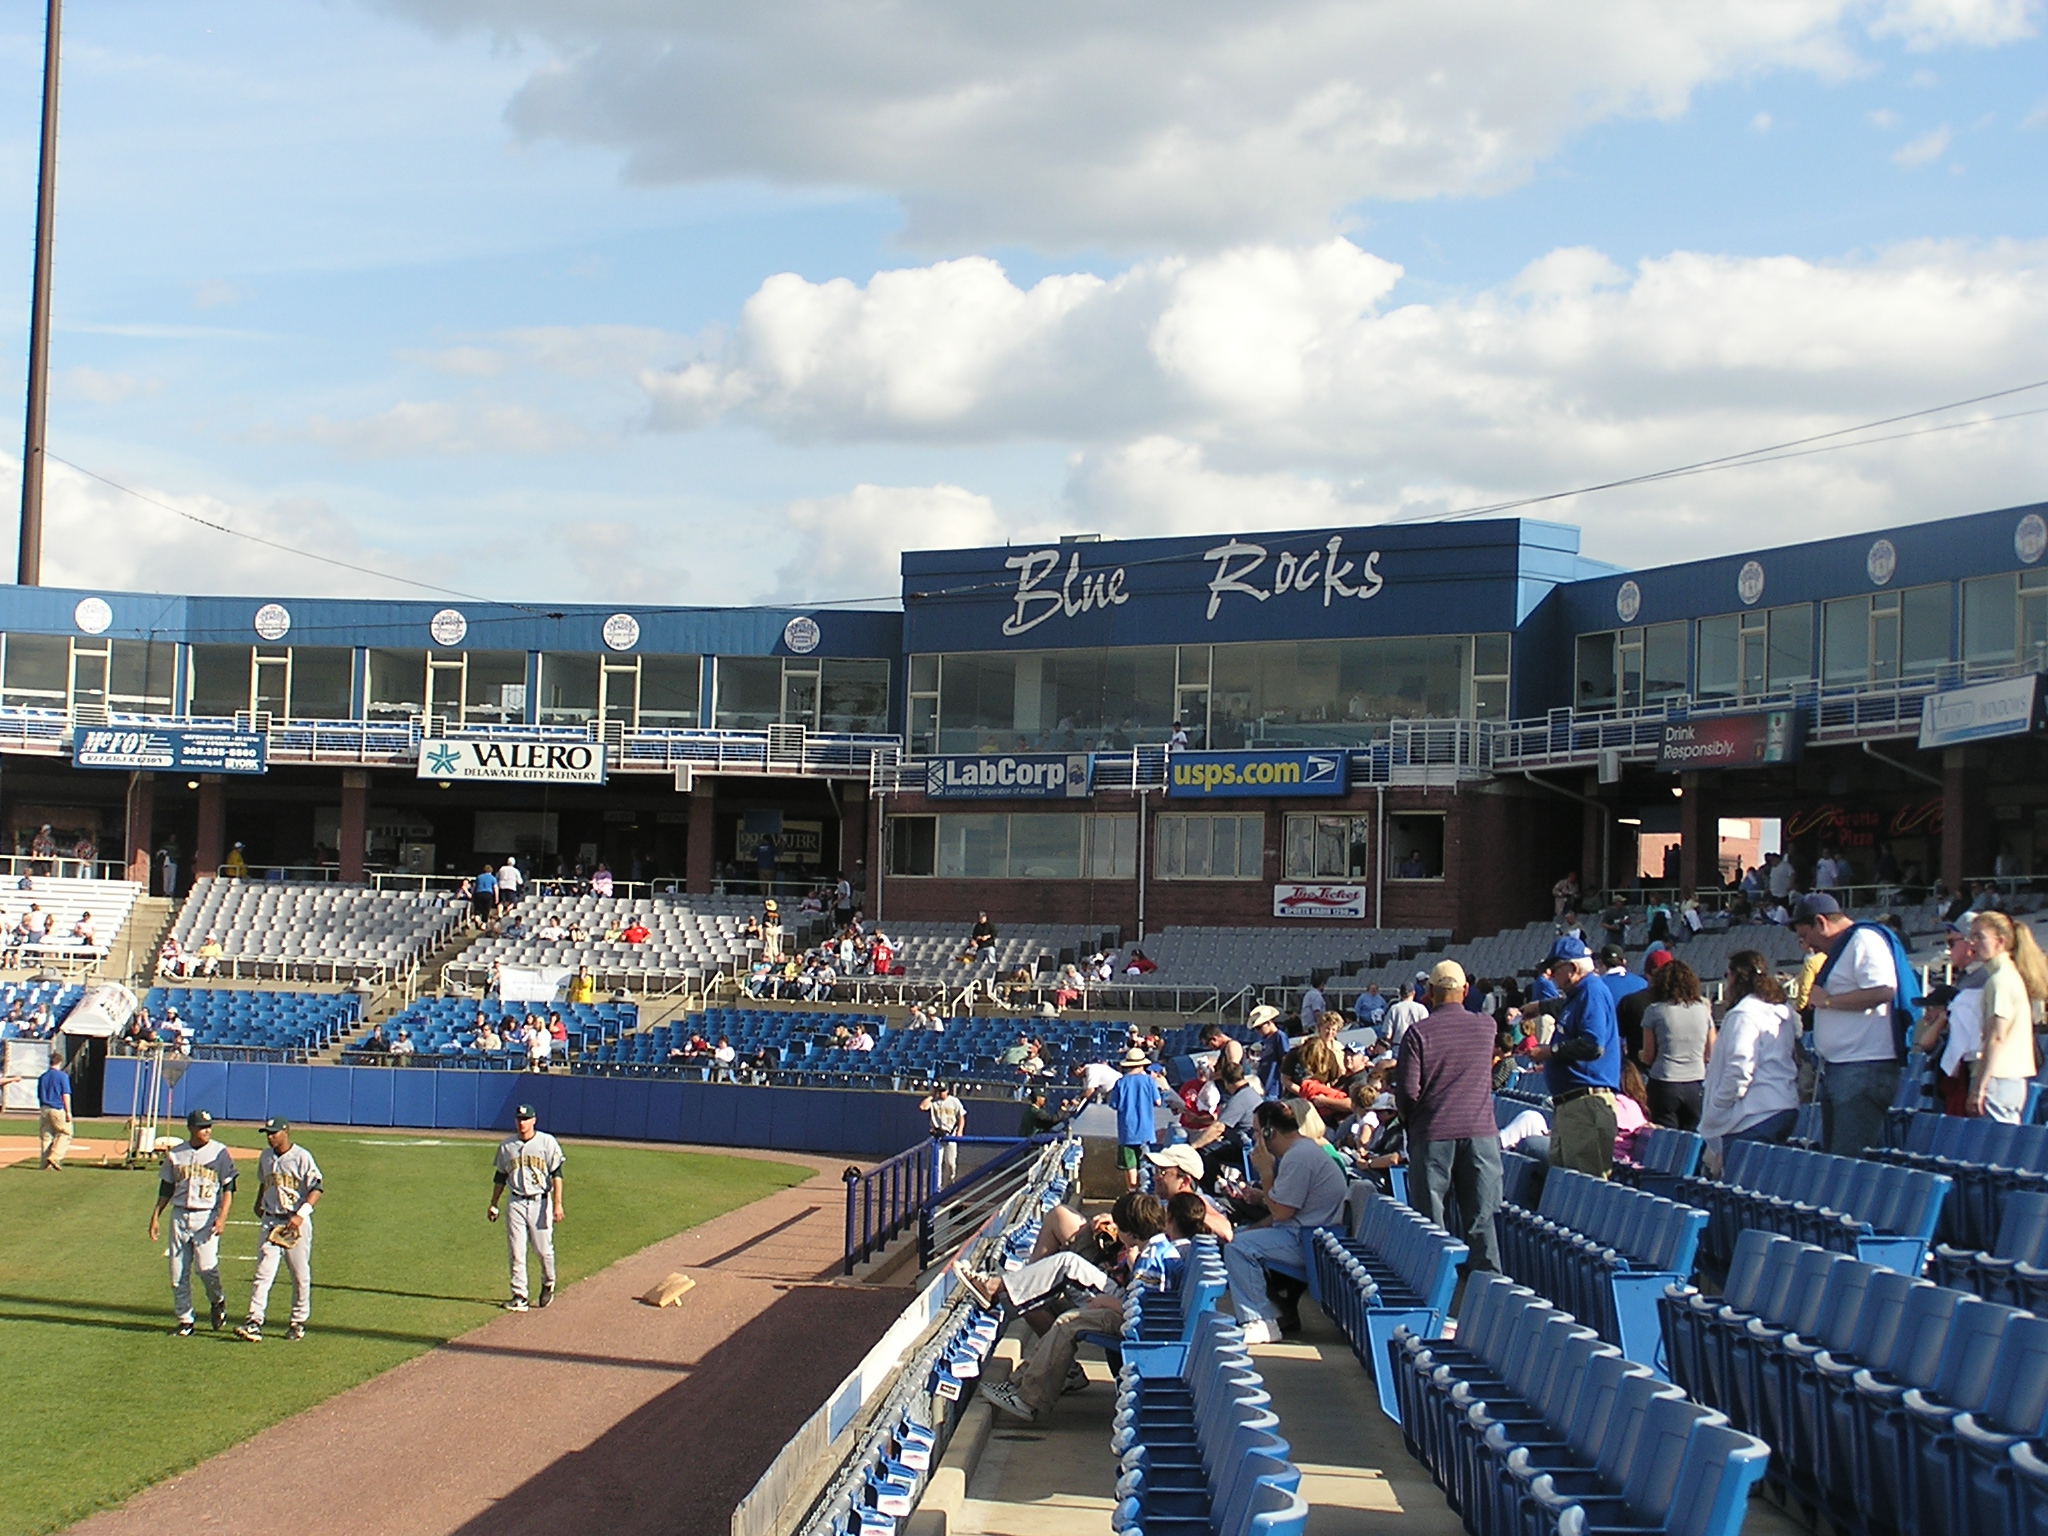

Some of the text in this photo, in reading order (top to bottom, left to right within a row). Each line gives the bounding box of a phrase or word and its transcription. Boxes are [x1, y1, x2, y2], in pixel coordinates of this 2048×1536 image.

[1002, 535, 1384, 636] Blue Rocks
[1665, 725, 1695, 741] Drink
[472, 743, 593, 770] VALERO
[1663, 740, 1736, 760] Responsibly.
[464, 768, 598, 781] DELAWARE CITY REFINERY
[946, 758, 1065, 789] LabCorp
[1174, 762, 1300, 792] usps.com
[199, 1184, 212, 1199] 12
